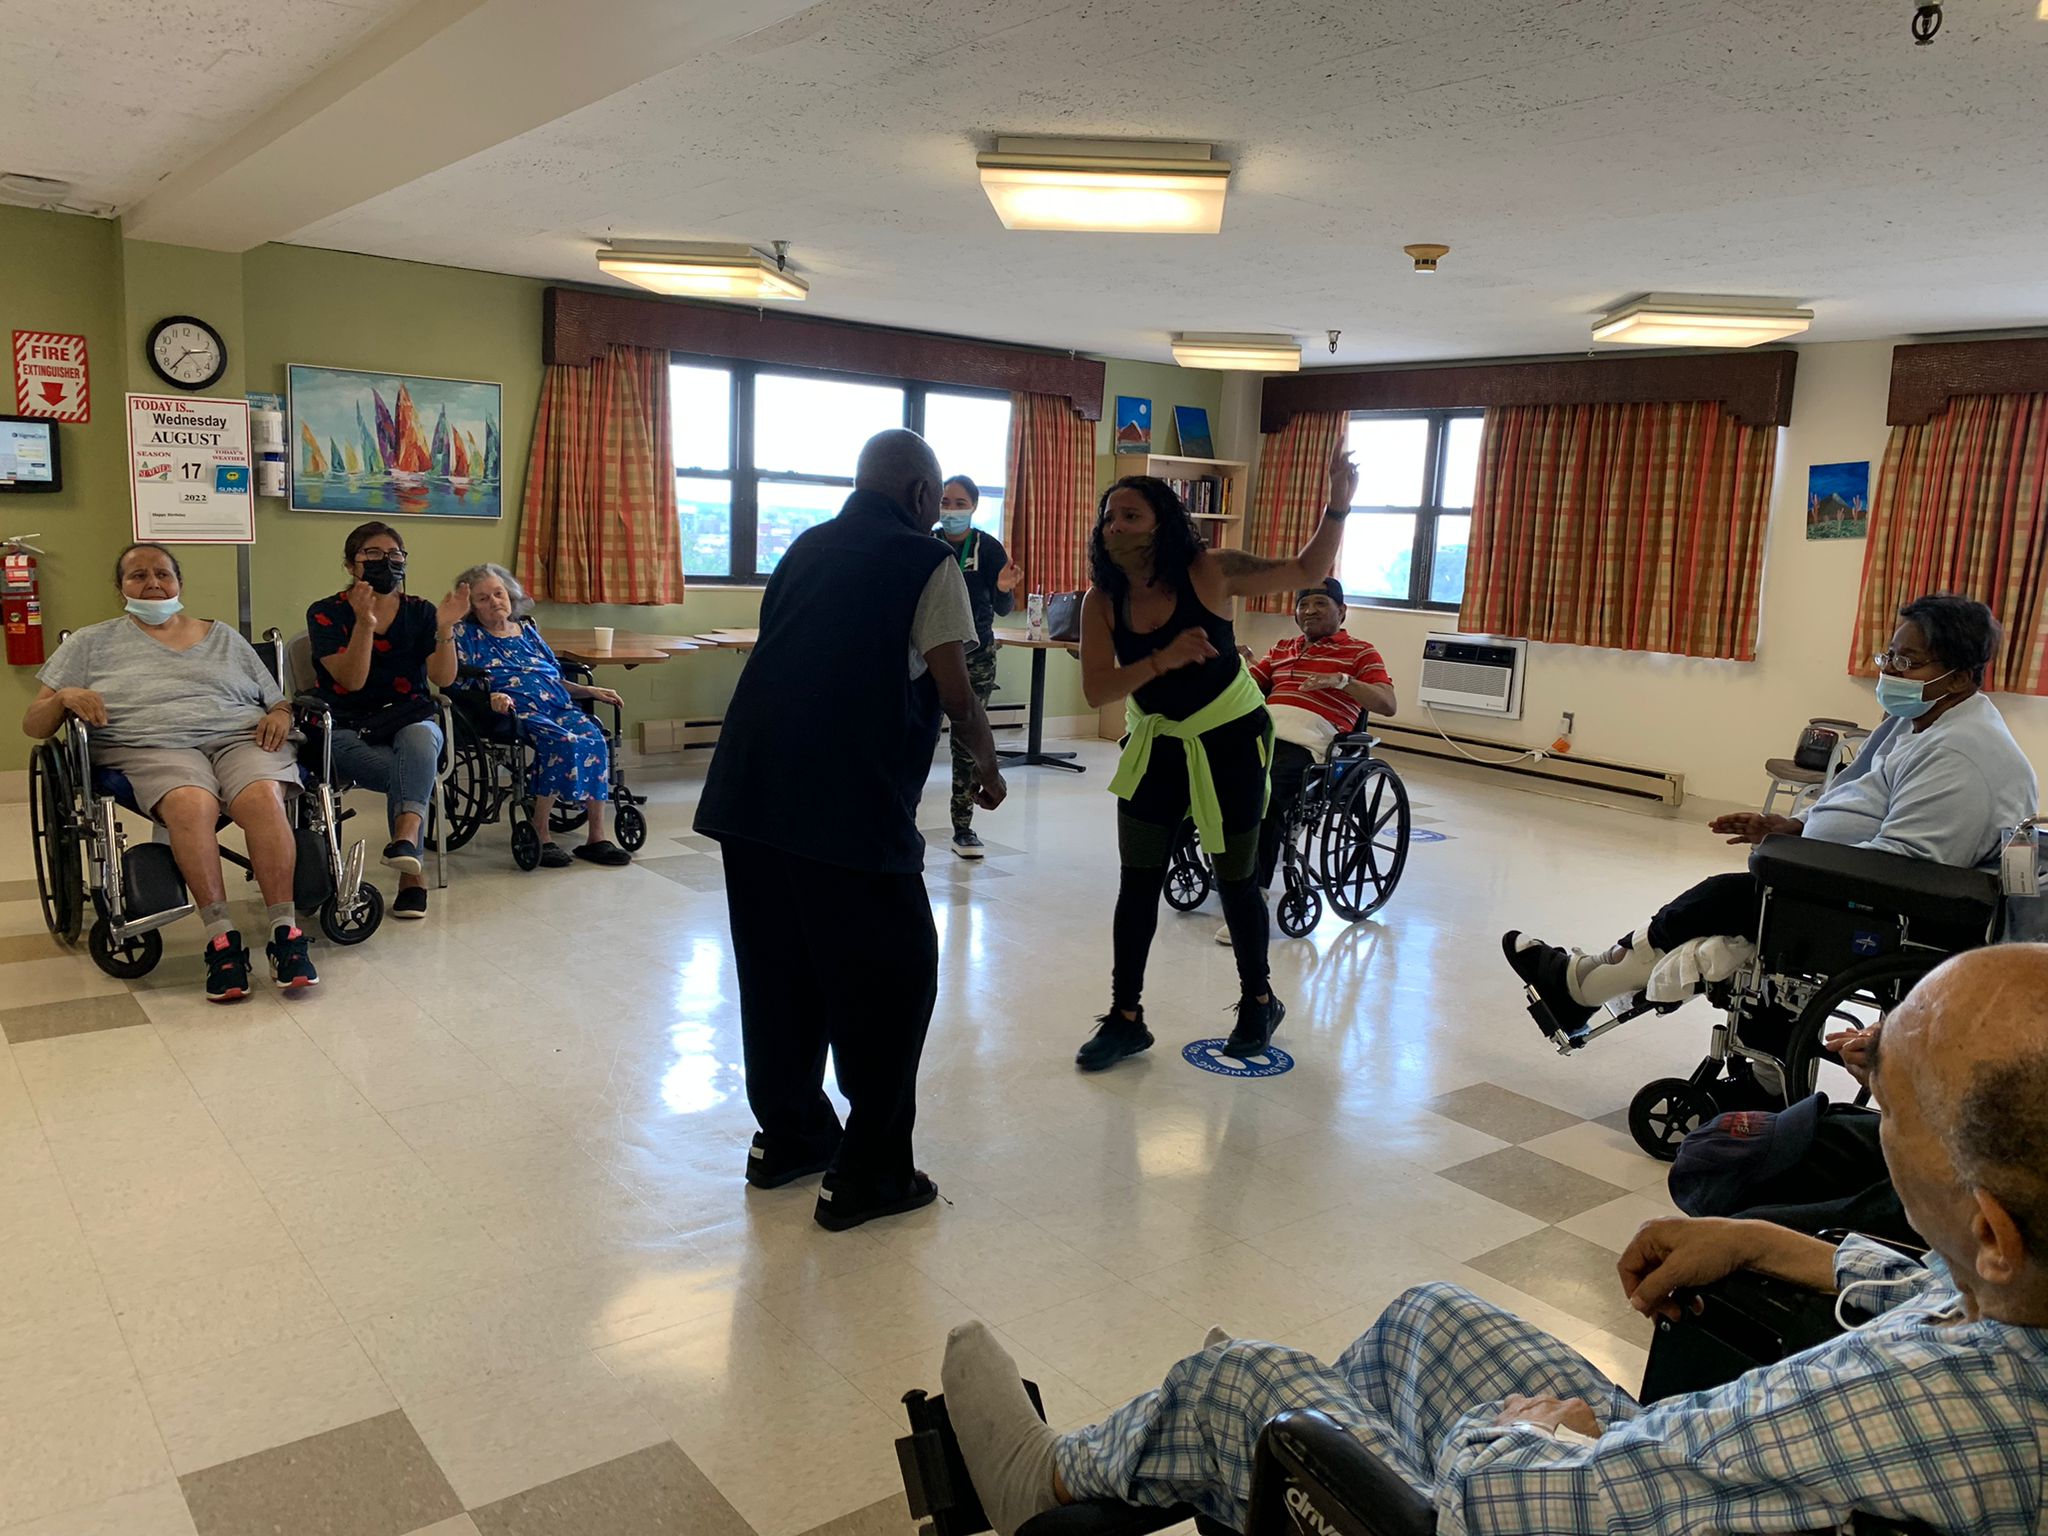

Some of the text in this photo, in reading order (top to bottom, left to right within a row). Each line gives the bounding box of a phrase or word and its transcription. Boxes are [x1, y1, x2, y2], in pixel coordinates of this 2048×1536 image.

[31, 345, 70, 362] FIRE
[22, 363, 81, 379] EXTINGUISHER
[133, 400, 195, 413] TODAY IS...
[153, 413, 227, 429] Wednesday
[151, 431, 221, 446] AUGUST
[181, 462, 202, 480] 17
[184, 494, 207, 502] 2022
[1196, 1060, 1281, 1076] DISTANCING
